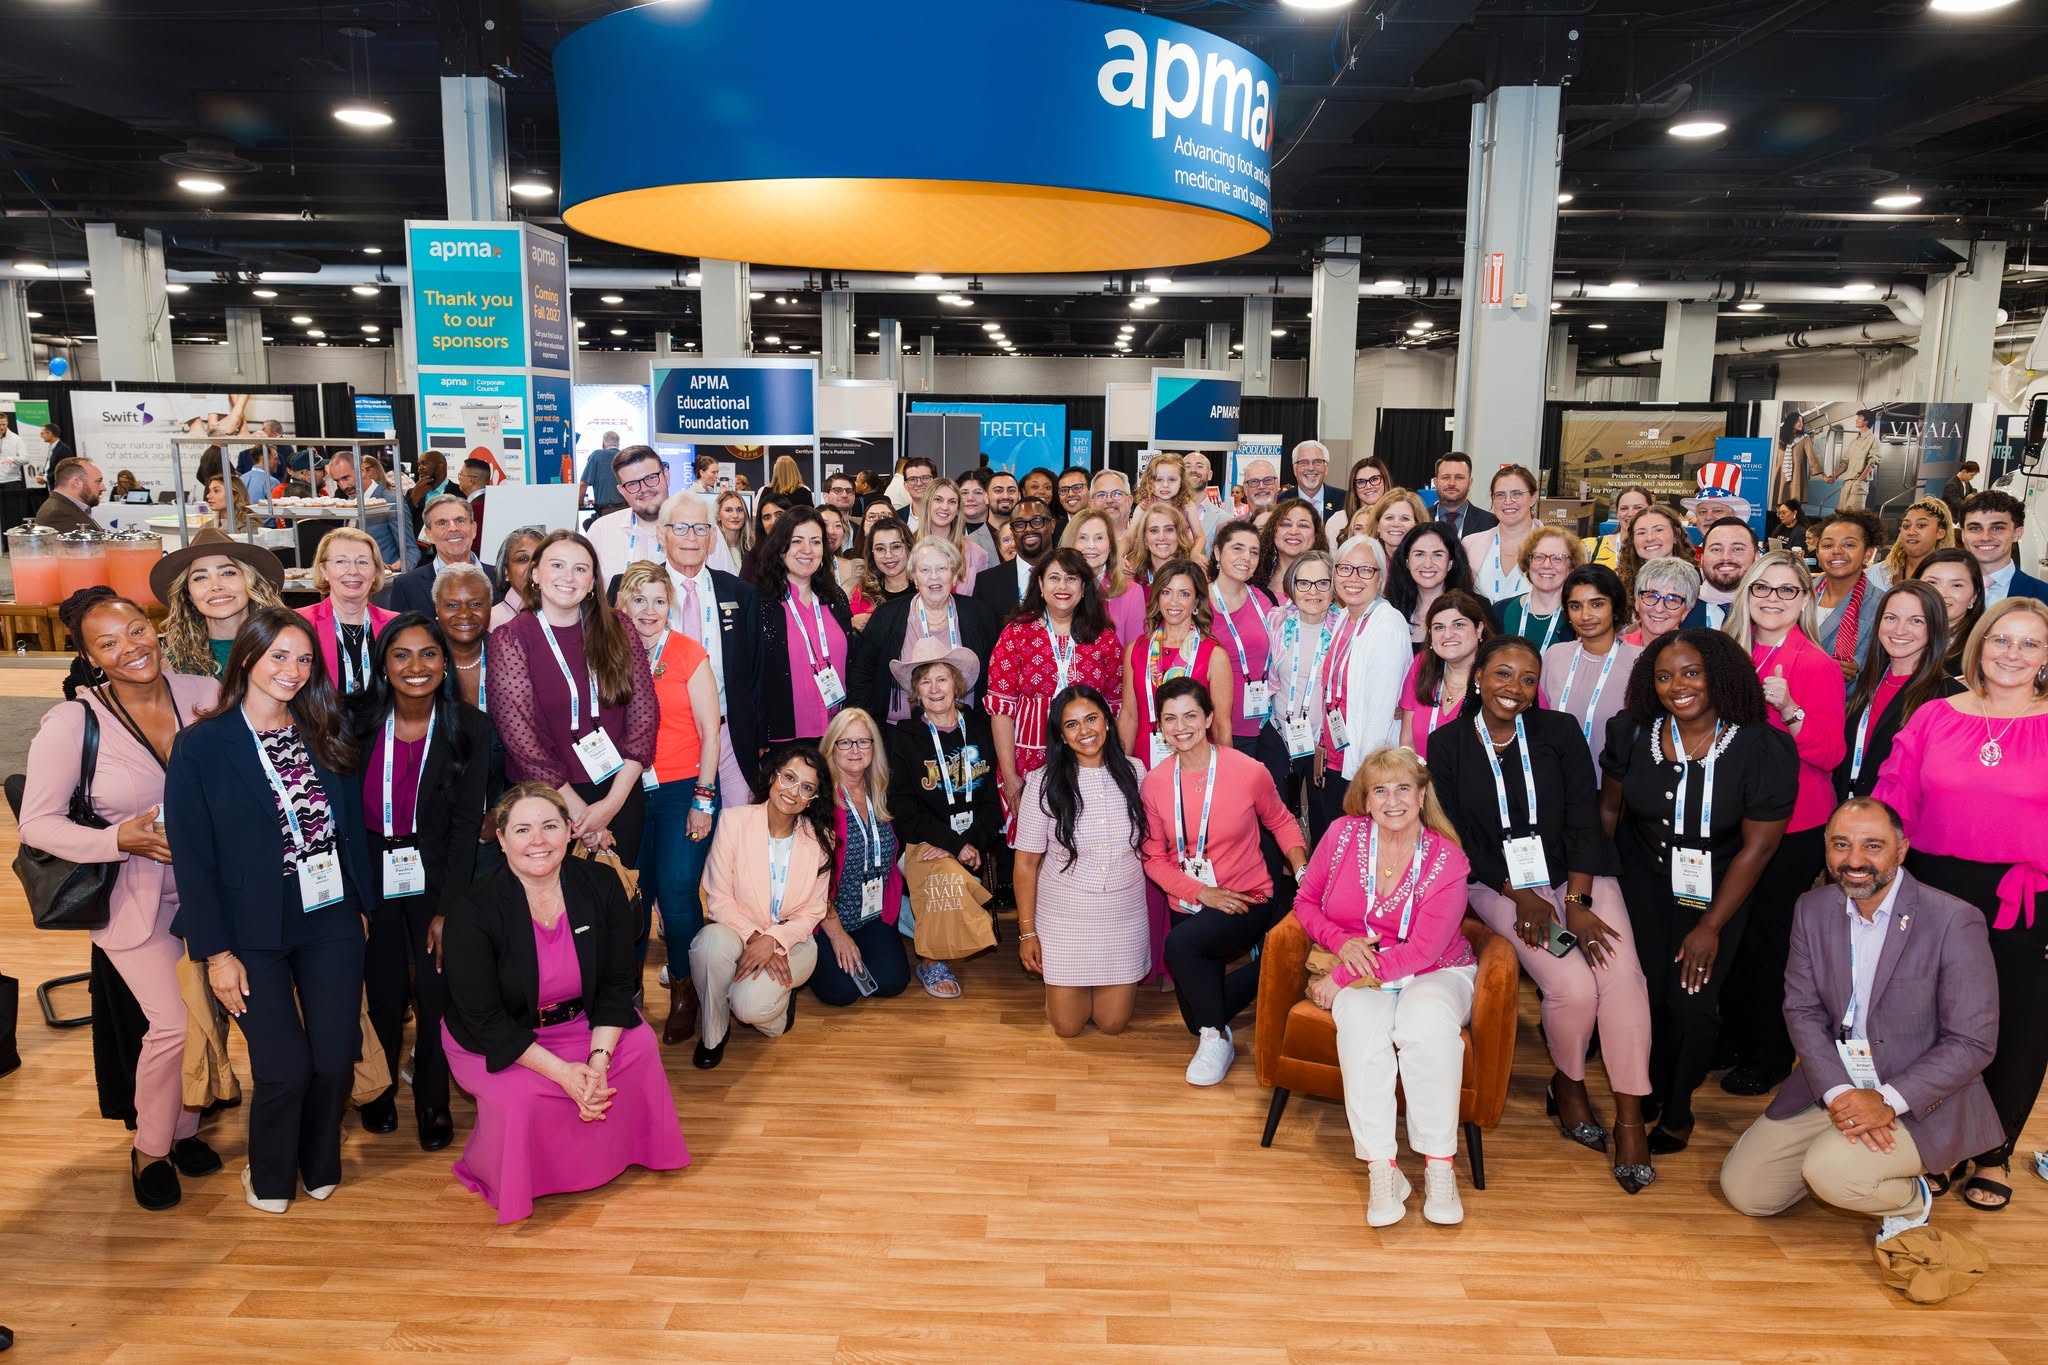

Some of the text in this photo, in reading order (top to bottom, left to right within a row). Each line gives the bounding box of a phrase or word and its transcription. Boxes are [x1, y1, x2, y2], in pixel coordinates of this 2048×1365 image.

[1097, 28, 1269, 152] apma
[1173, 134, 1235, 174] Advancing
[1237, 153, 1253, 178] foot
[1253, 166, 1264, 184] and
[1174, 169, 1269, 218] medicine and surgery
[429, 240, 492, 262] apma
[531, 245, 556, 266] apma
[424, 290, 513, 310] Thank you
[534, 284, 559, 306] Coming
[443, 312, 496, 328] to our
[533, 304, 561, 323] Fall 2027
[432, 335, 509, 350] sponsors
[440, 377, 468, 387] apma
[476, 379, 505, 387] Corporate
[690, 375, 730, 390] APMA
[537, 391, 555, 402] Everything
[677, 395, 750, 410] Educational
[102, 411, 139, 423] Swift
[679, 415, 749, 430] Foundation
[1890, 421, 1962, 439] VIVAIA
[105, 440, 127, 450] Your
[129, 440, 163, 450] natural
[539, 436, 558, 445] exceptional
[1073, 437, 1089, 445] TRY
[105, 450, 116, 460] of
[119, 451, 149, 460] attack
[1073, 445, 1088, 454] ME!
[1242, 445, 1282, 455] PODIATRIC
[1611, 472, 1642, 480] Proactive,
[1656, 480, 1684, 488] Advisory
